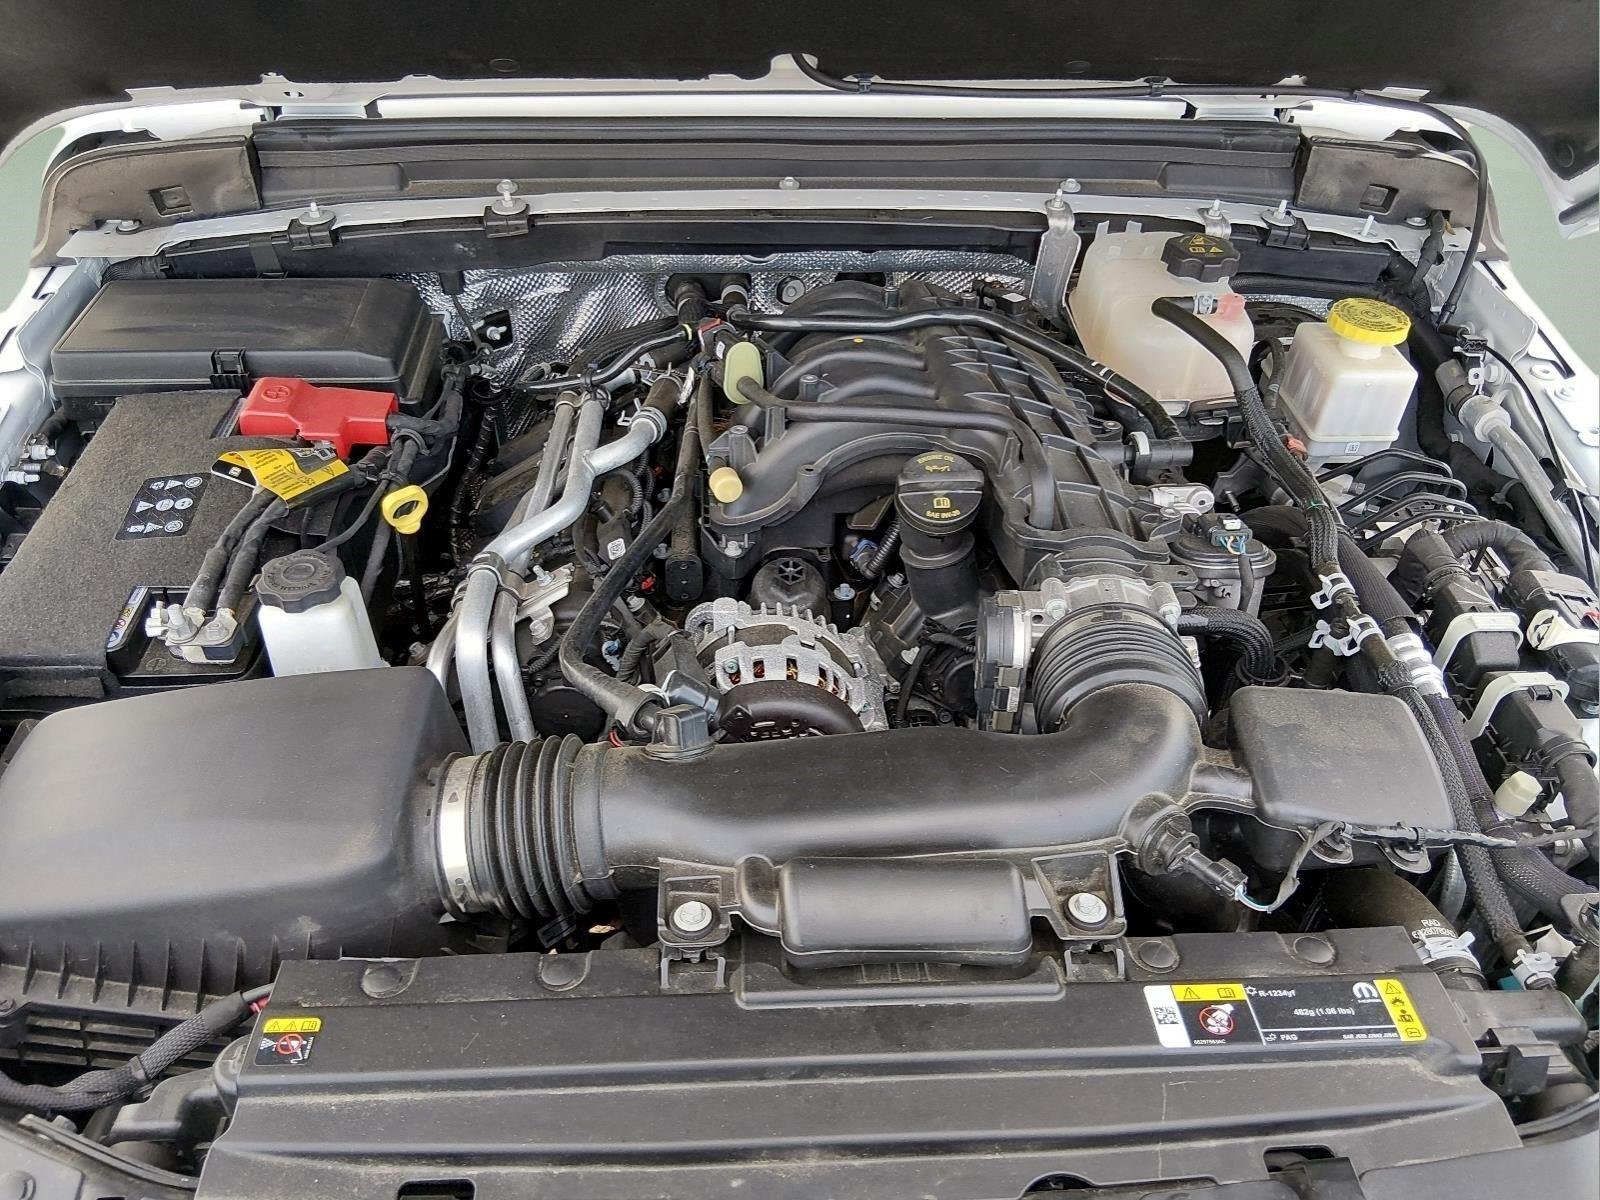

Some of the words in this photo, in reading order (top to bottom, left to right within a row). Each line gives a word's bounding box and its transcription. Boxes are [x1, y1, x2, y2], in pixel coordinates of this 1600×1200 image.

[916, 454, 943, 464] ENGINE
[943, 454, 955, 463] OIL
[926, 510, 940, 519] SAE
[1420, 918, 1441, 927] RAD
[1258, 989, 1296, 998] R-1234yf
[1338, 1007, 1356, 1016] lbs)
[1280, 1033, 1298, 1041] PAG
